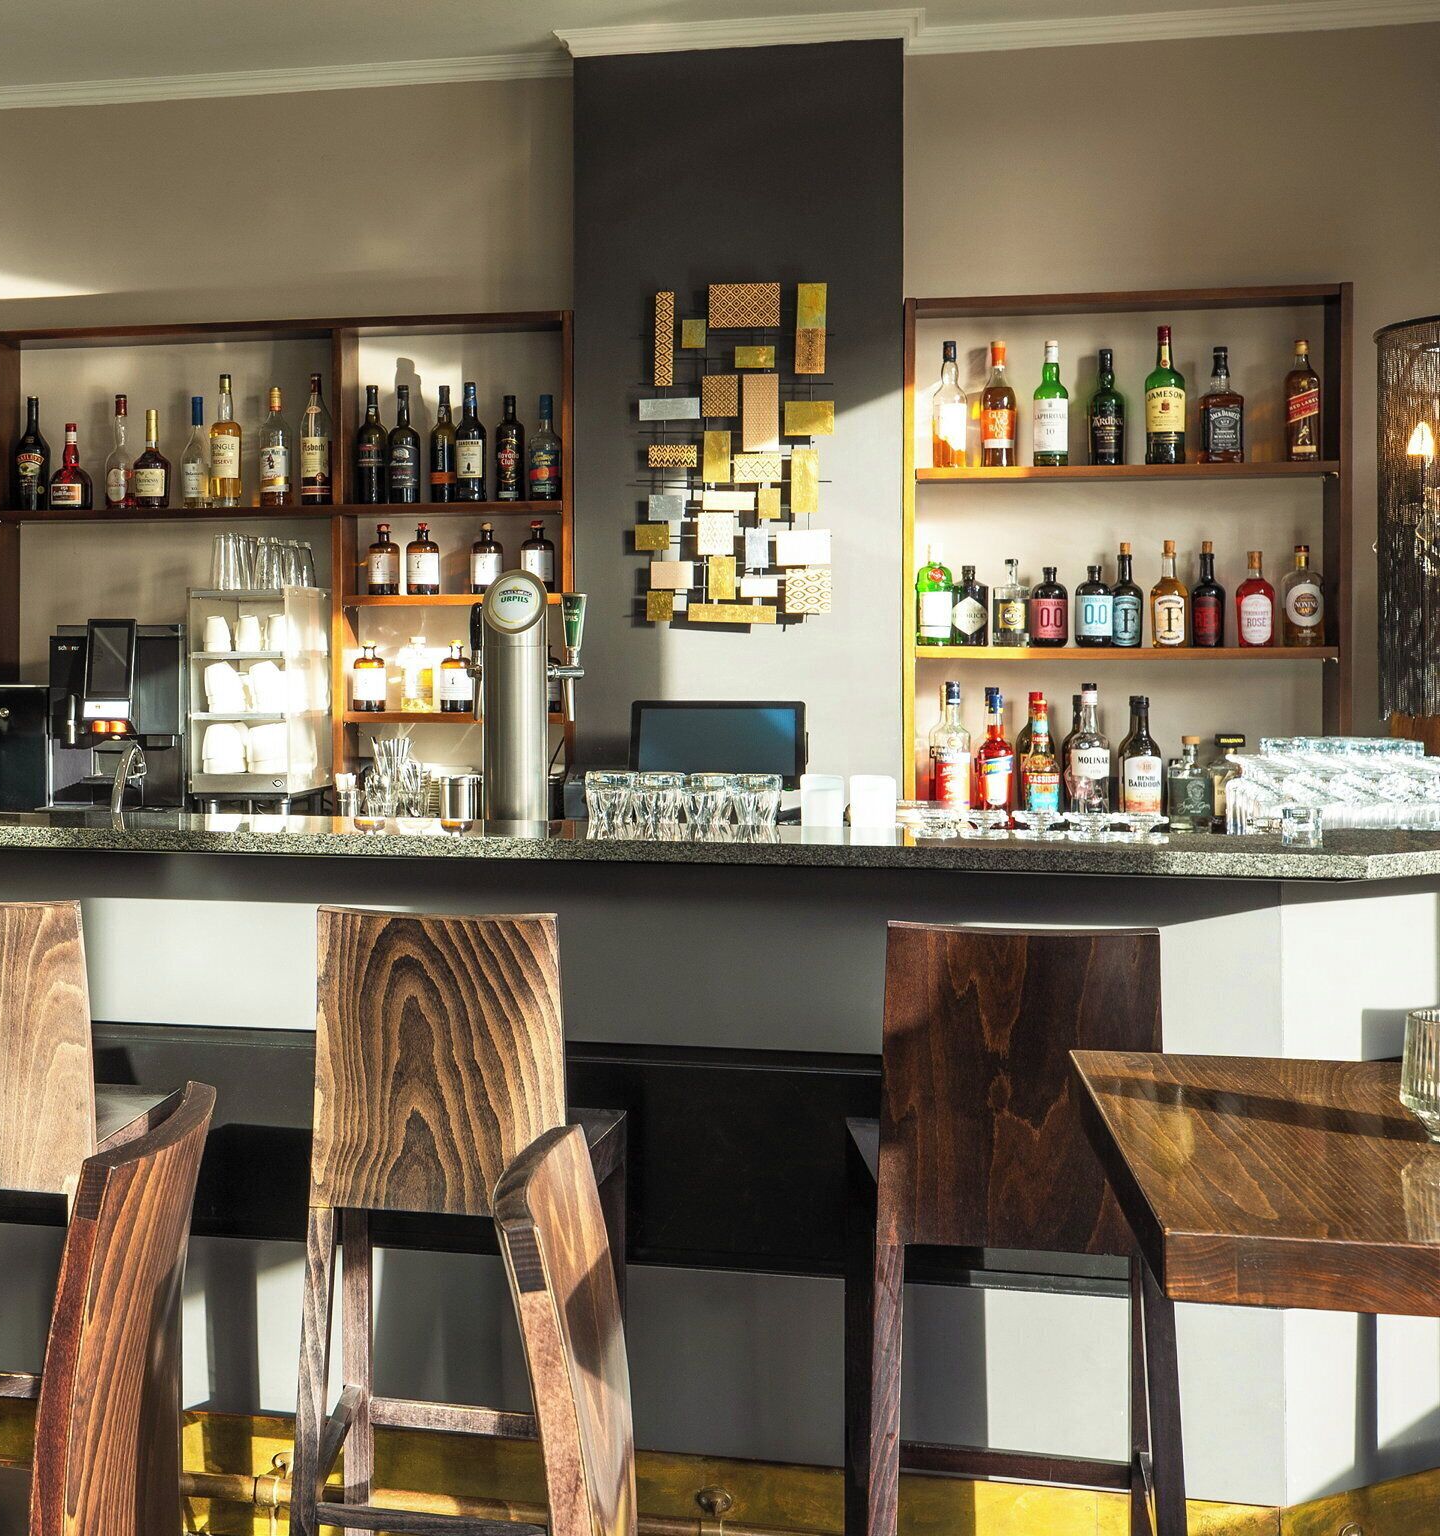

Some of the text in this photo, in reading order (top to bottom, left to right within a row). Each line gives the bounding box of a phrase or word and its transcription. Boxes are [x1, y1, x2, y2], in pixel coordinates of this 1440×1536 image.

[1147, 390, 1184, 401] JAMESON
[1301, 397, 1319, 407] LABEL
[1209, 410, 1222, 420] JACK
[500, 595, 529, 603] URPILS
[1120, 608, 1139, 634] F
[1164, 607, 1183, 633] F
